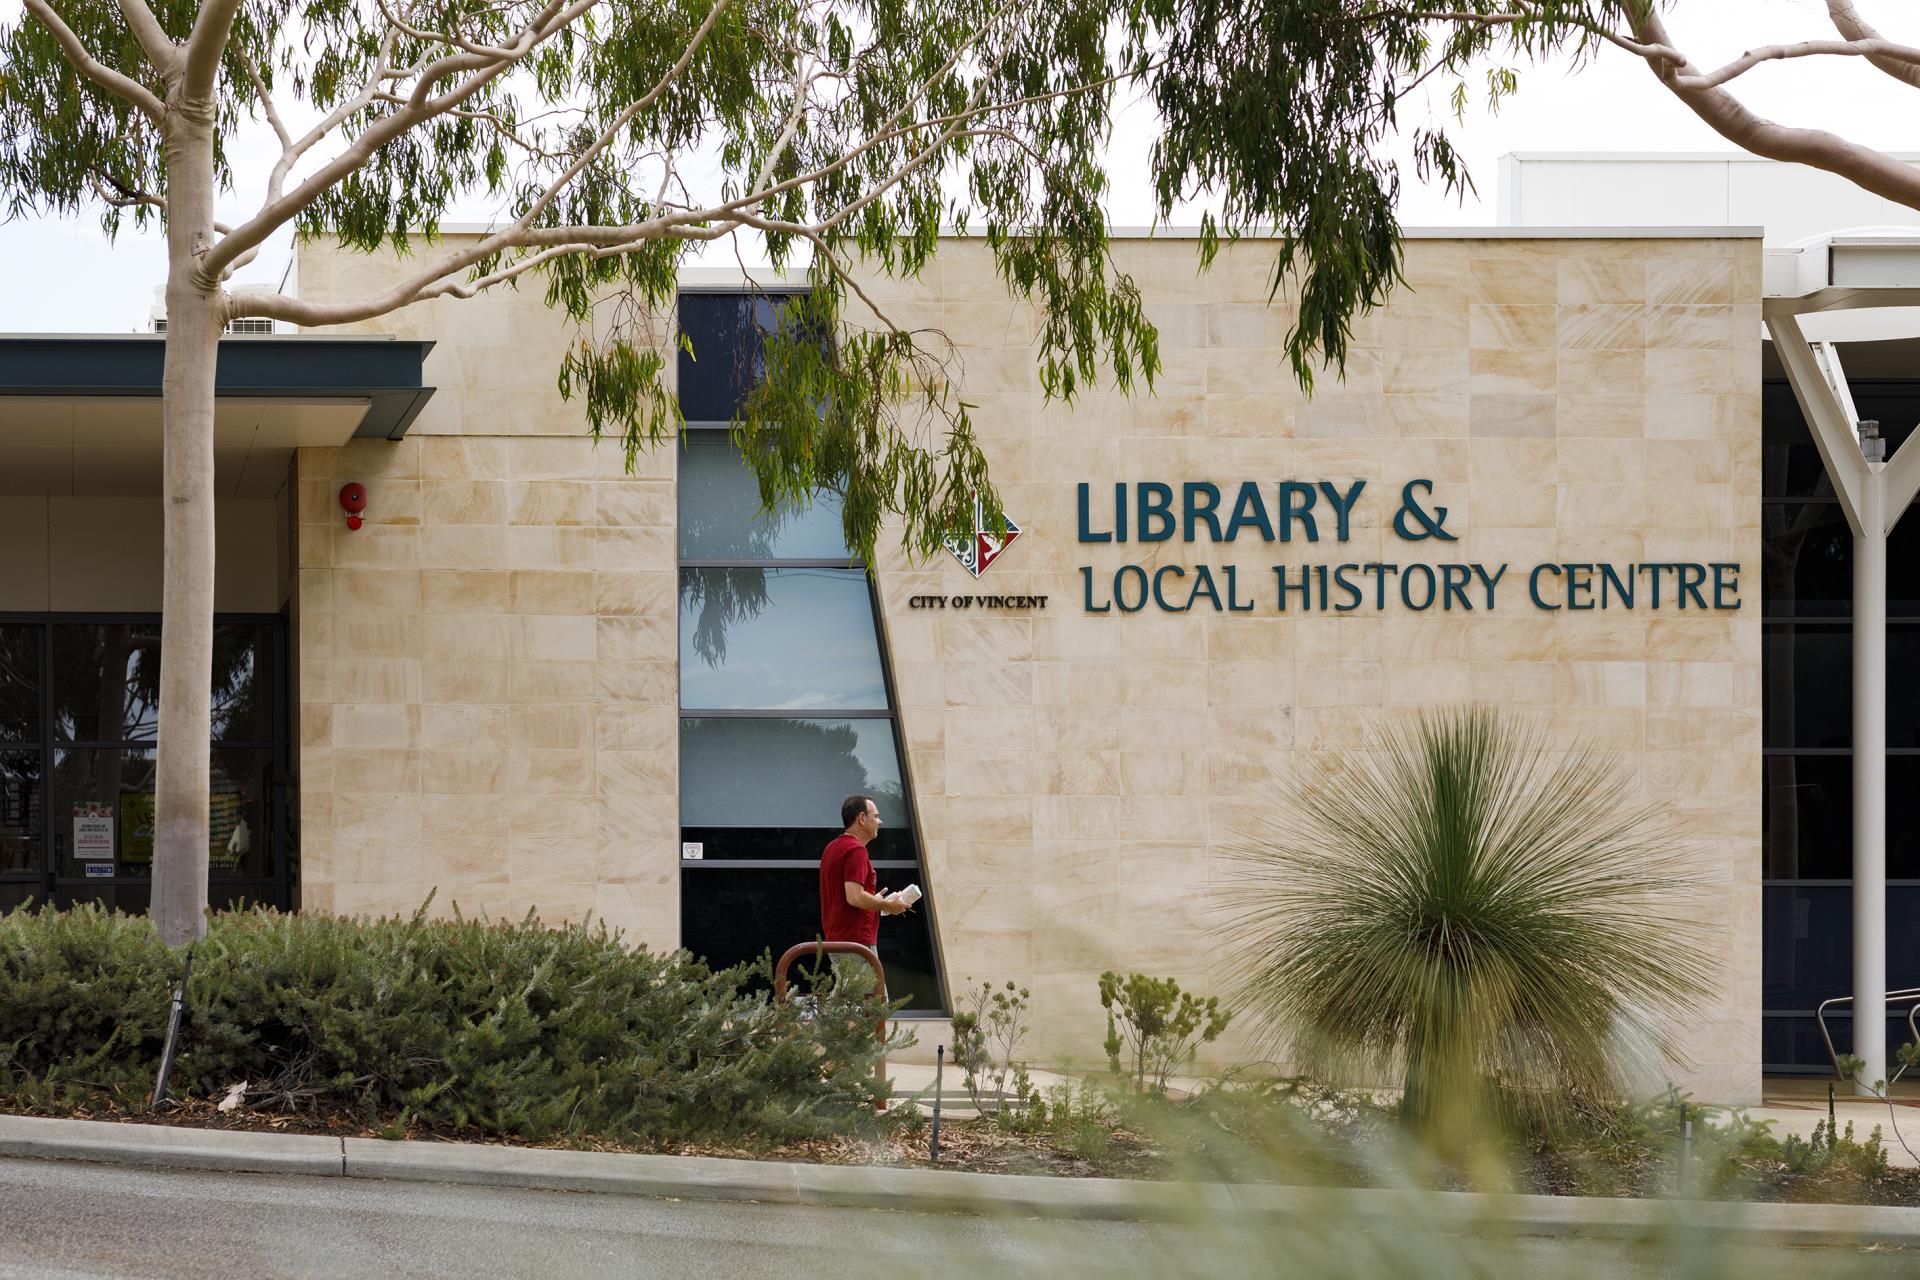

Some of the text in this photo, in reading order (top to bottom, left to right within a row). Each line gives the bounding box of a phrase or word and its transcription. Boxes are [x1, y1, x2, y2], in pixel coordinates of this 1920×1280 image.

[1077, 479, 1458, 543] LIBRARY &
[909, 595, 1048, 609] CITY OF VINCENT
[1079, 562, 1742, 613] LOCAL HISTORY CENTRE
